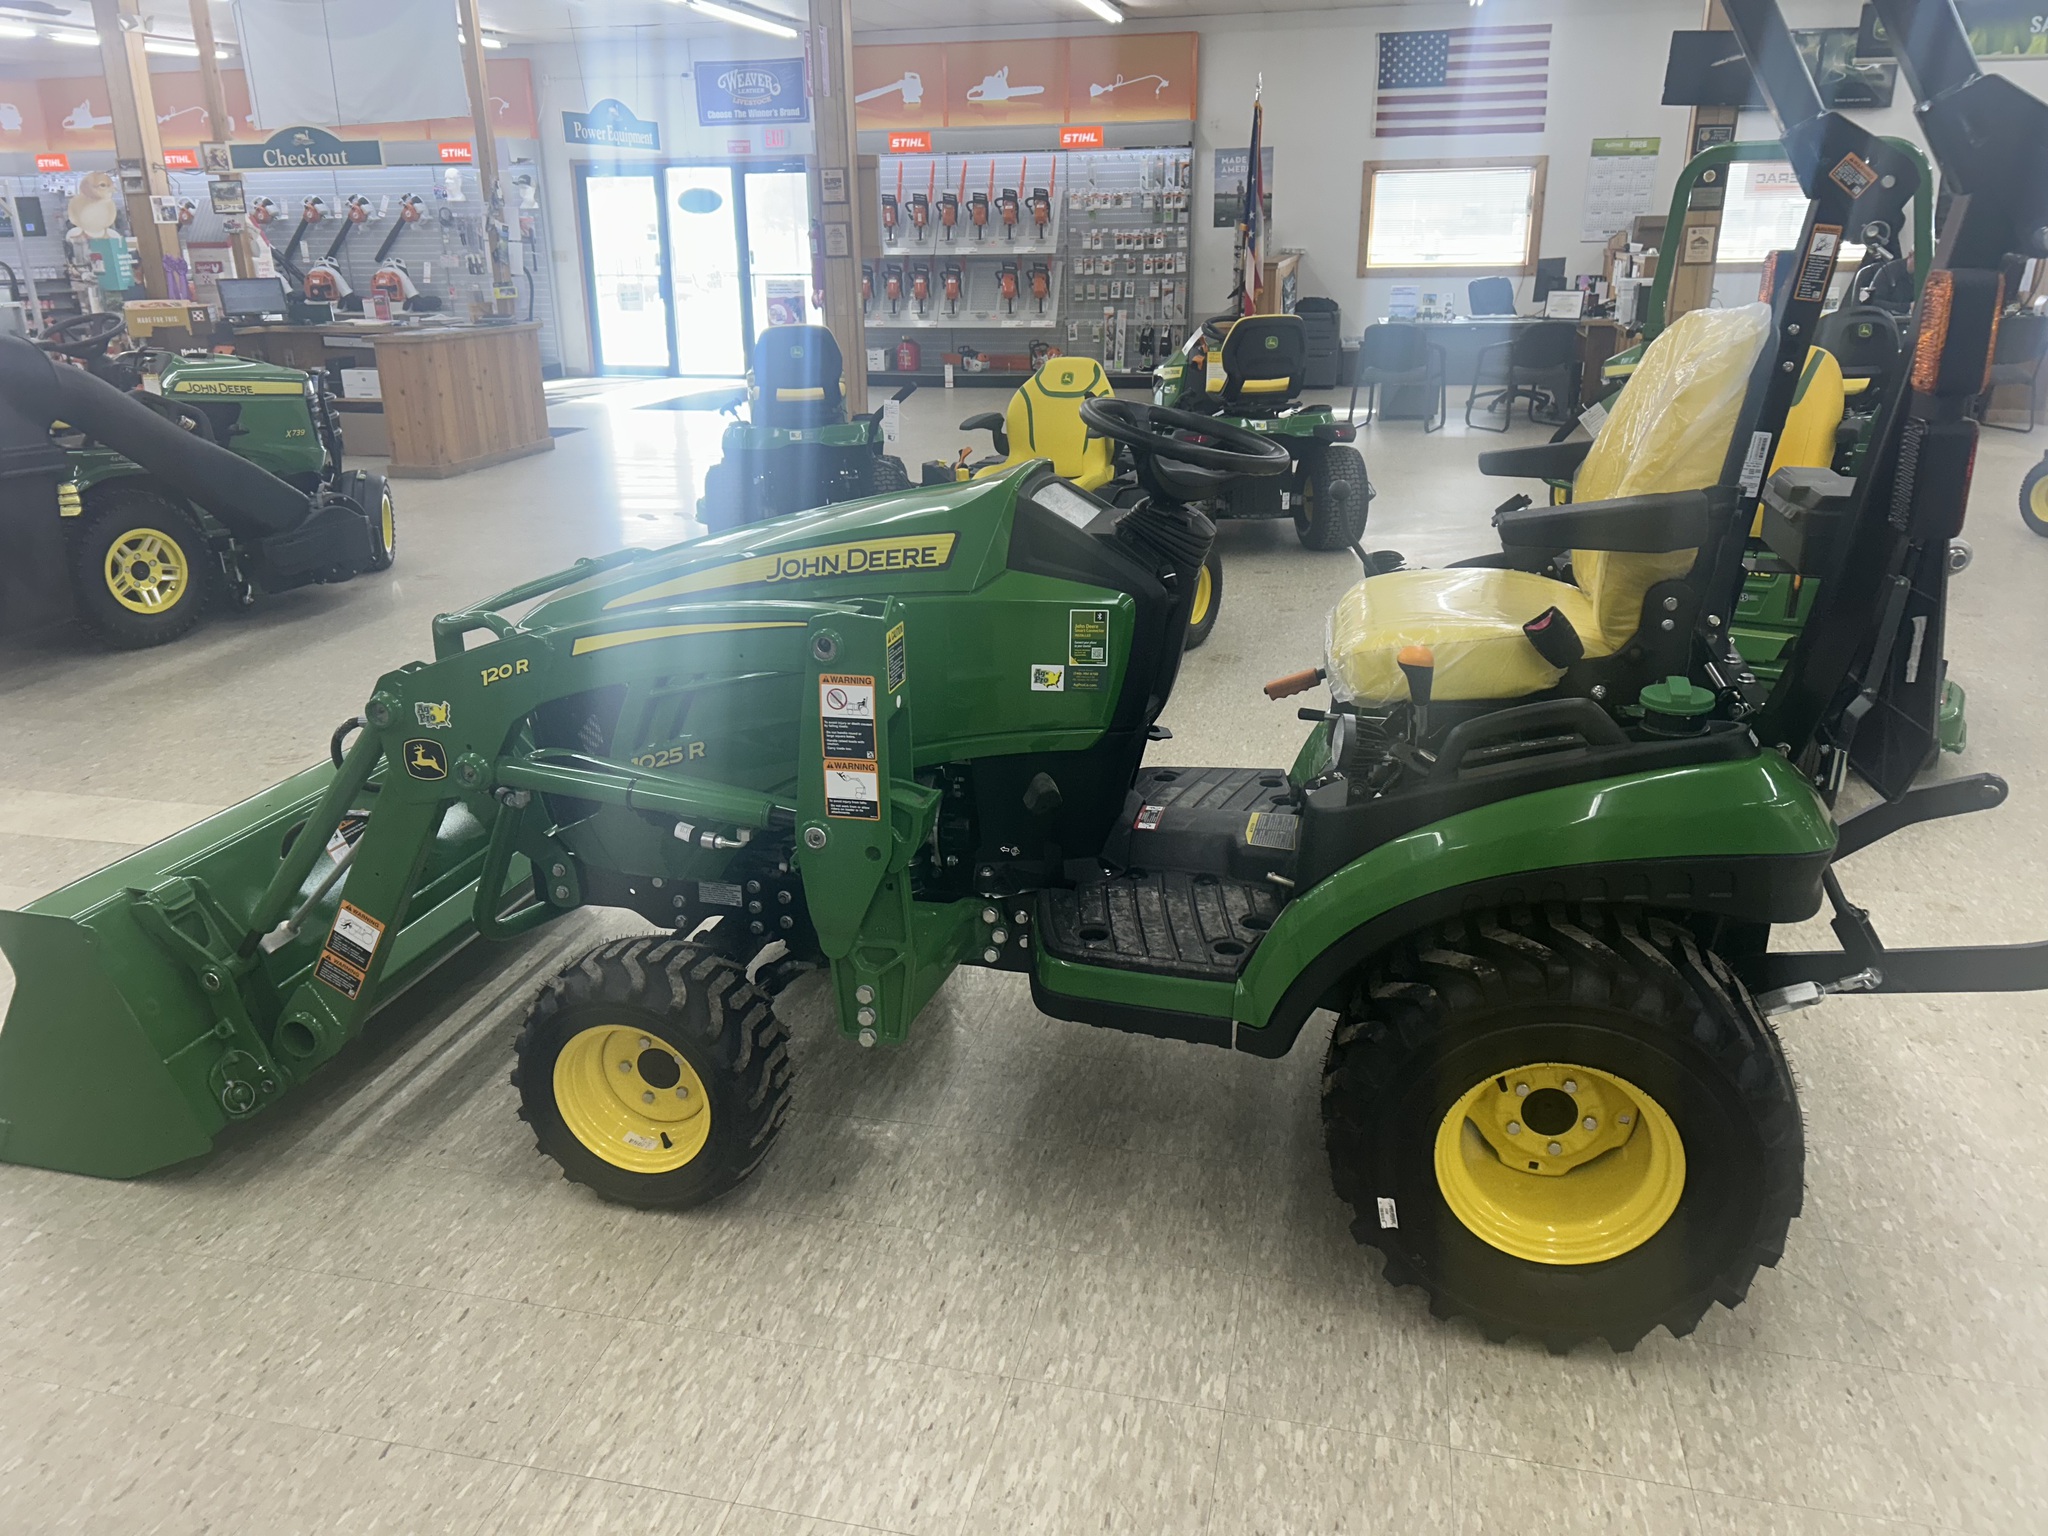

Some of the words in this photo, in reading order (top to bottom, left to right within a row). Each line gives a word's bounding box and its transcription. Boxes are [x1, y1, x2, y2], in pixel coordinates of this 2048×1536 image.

[718, 69, 781, 96] WEAVER
[732, 96, 772, 106] LIVESTOCK
[707, 110, 732, 119] Choose
[734, 109, 747, 119] The
[748, 108, 779, 118] Winner's
[779, 107, 800, 117] Brand
[573, 121, 606, 141] Power
[606, 124, 654, 147] Equipment
[765, 129, 785, 147] EXIT
[1062, 133, 1099, 144] STIHL
[891, 138, 925, 148] STIHL
[263, 147, 349, 167] Checkout
[441, 148, 471, 159] STIHL
[37, 158, 64, 168] STIHL
[165, 154, 192, 165] STIHL
[1221, 155, 1247, 165] MADE
[1221, 165, 1249, 174] AMERI
[186, 382, 217, 394] JOHN
[218, 382, 255, 394] DEERE
[285, 429, 306, 438] X739
[766, 555, 841, 581] JOHN
[847, 546, 940, 571] DEERE
[480, 663, 513, 687] 120
[515, 658, 530, 675] R
[830, 675, 872, 685] WARNING
[688, 741, 706, 760] R
[834, 761, 875, 772] WARNING
[352, 908, 380, 928] WARNING
[333, 958, 361, 978] WARNING
